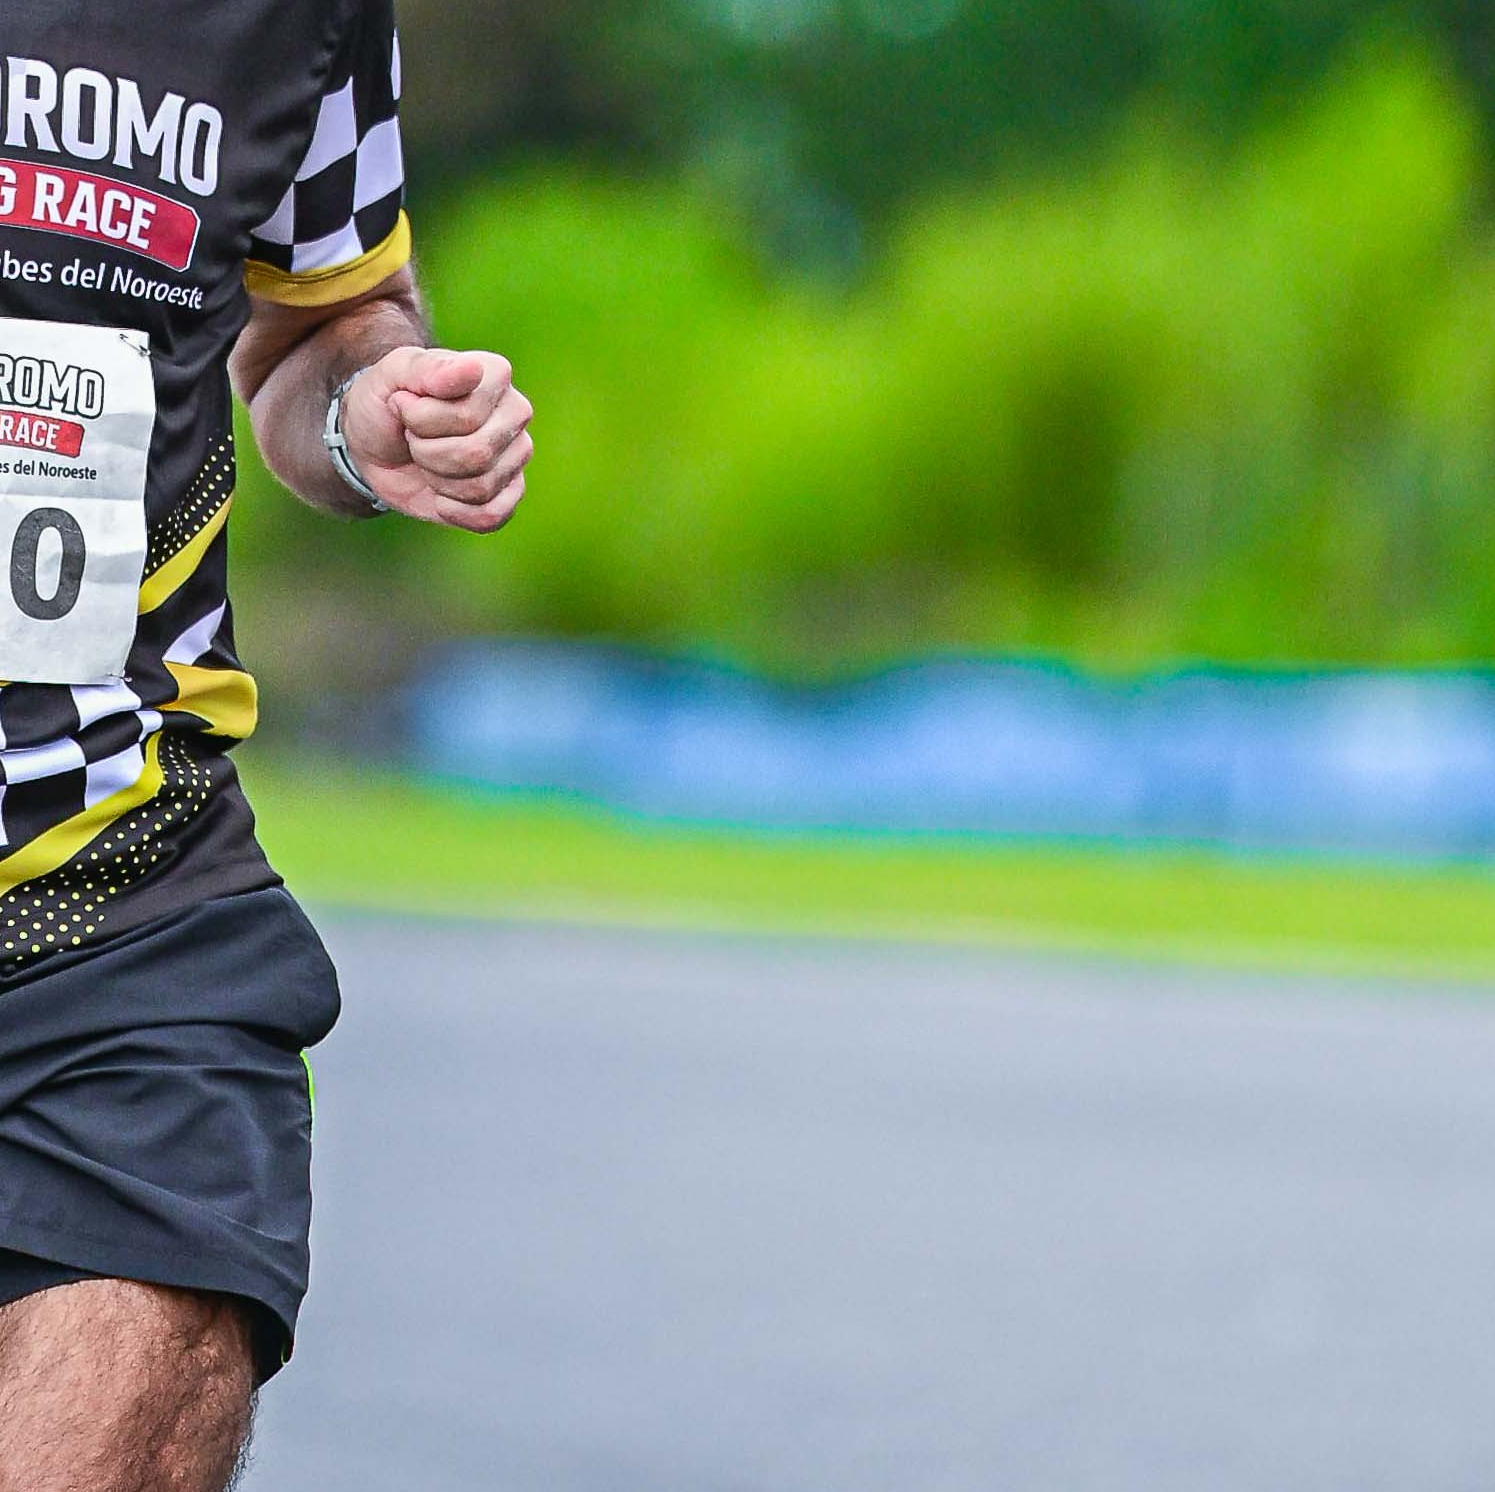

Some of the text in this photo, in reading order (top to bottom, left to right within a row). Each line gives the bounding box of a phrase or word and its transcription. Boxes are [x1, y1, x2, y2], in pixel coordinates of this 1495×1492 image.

[31, 168, 156, 250] RACE
[60, 258, 106, 290] del
[110, 265, 204, 310] Noroeste
[13, 459, 36, 476] del
[38, 461, 97, 480] Noroeste
